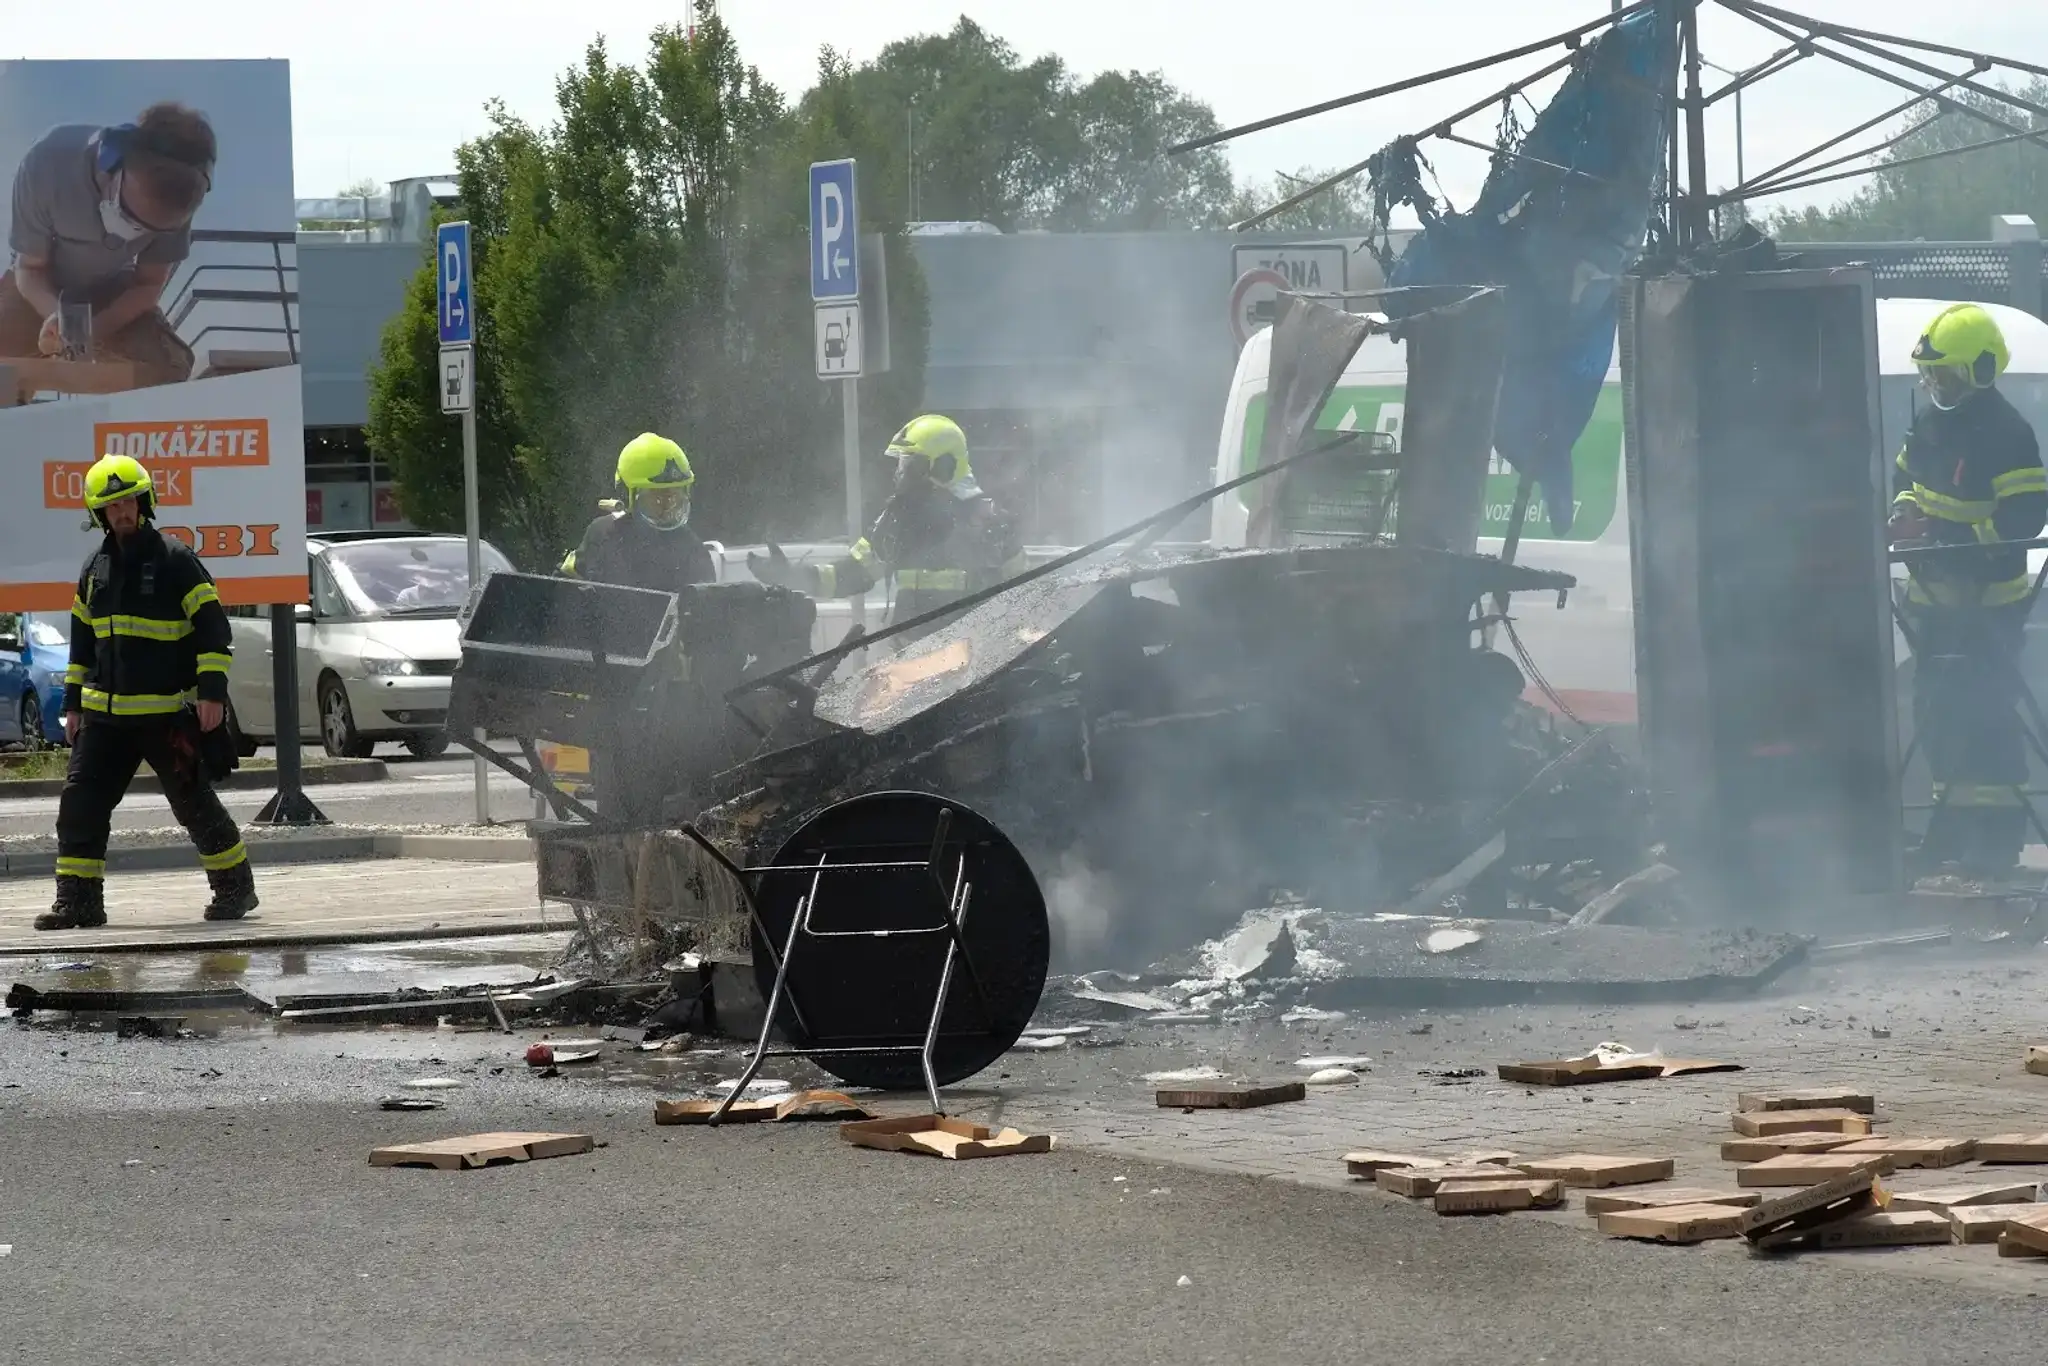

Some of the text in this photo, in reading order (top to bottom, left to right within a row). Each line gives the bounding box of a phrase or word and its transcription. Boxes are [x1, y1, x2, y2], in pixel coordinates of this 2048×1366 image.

[820, 182, 844, 280] P
[445, 241, 461, 328] P
[1258, 252, 1321, 288] ÓNA
[105, 424, 259, 459] DOKÁŽETE
